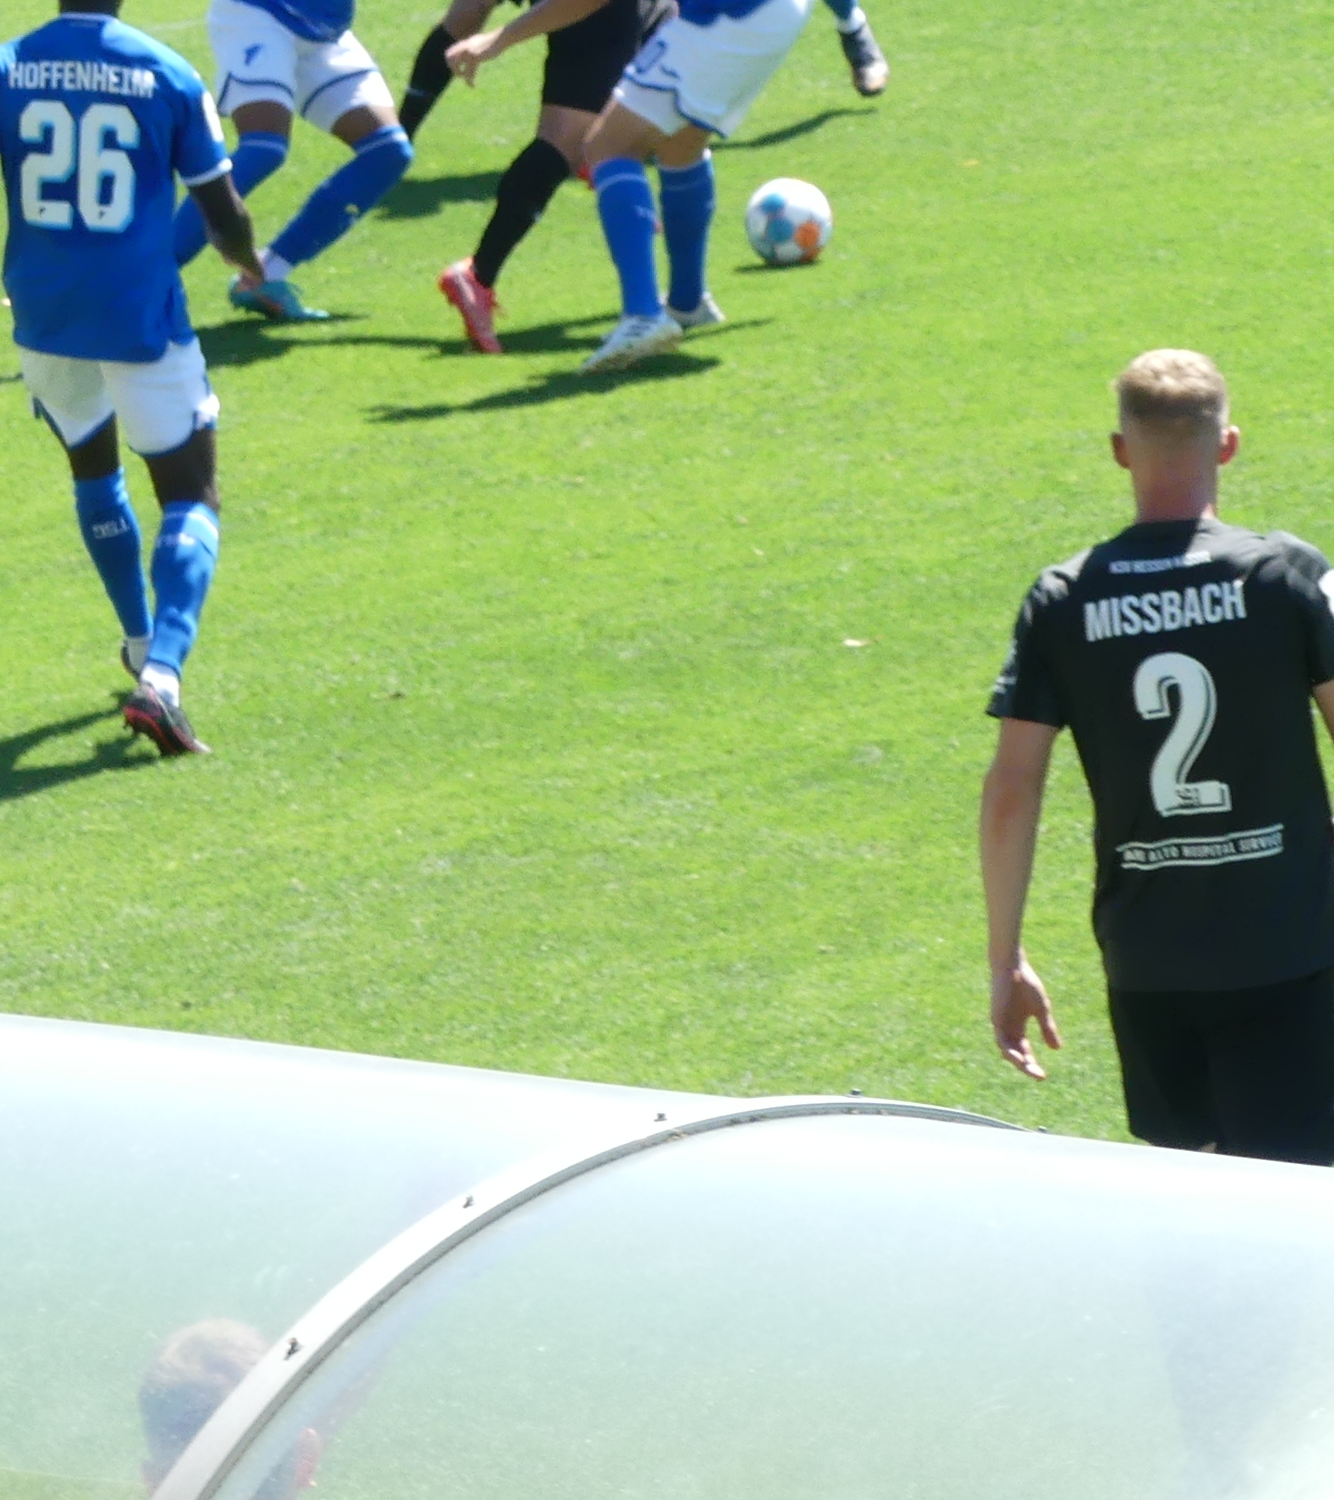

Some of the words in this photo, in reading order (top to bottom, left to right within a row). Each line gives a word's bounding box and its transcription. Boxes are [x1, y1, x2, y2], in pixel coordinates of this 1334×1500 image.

[8, 61, 157, 99] HOFFENHEIM
[20, 99, 141, 234] 26
[1084, 579, 1247, 643] MISSBACH
[1133, 652, 1232, 818] 2
